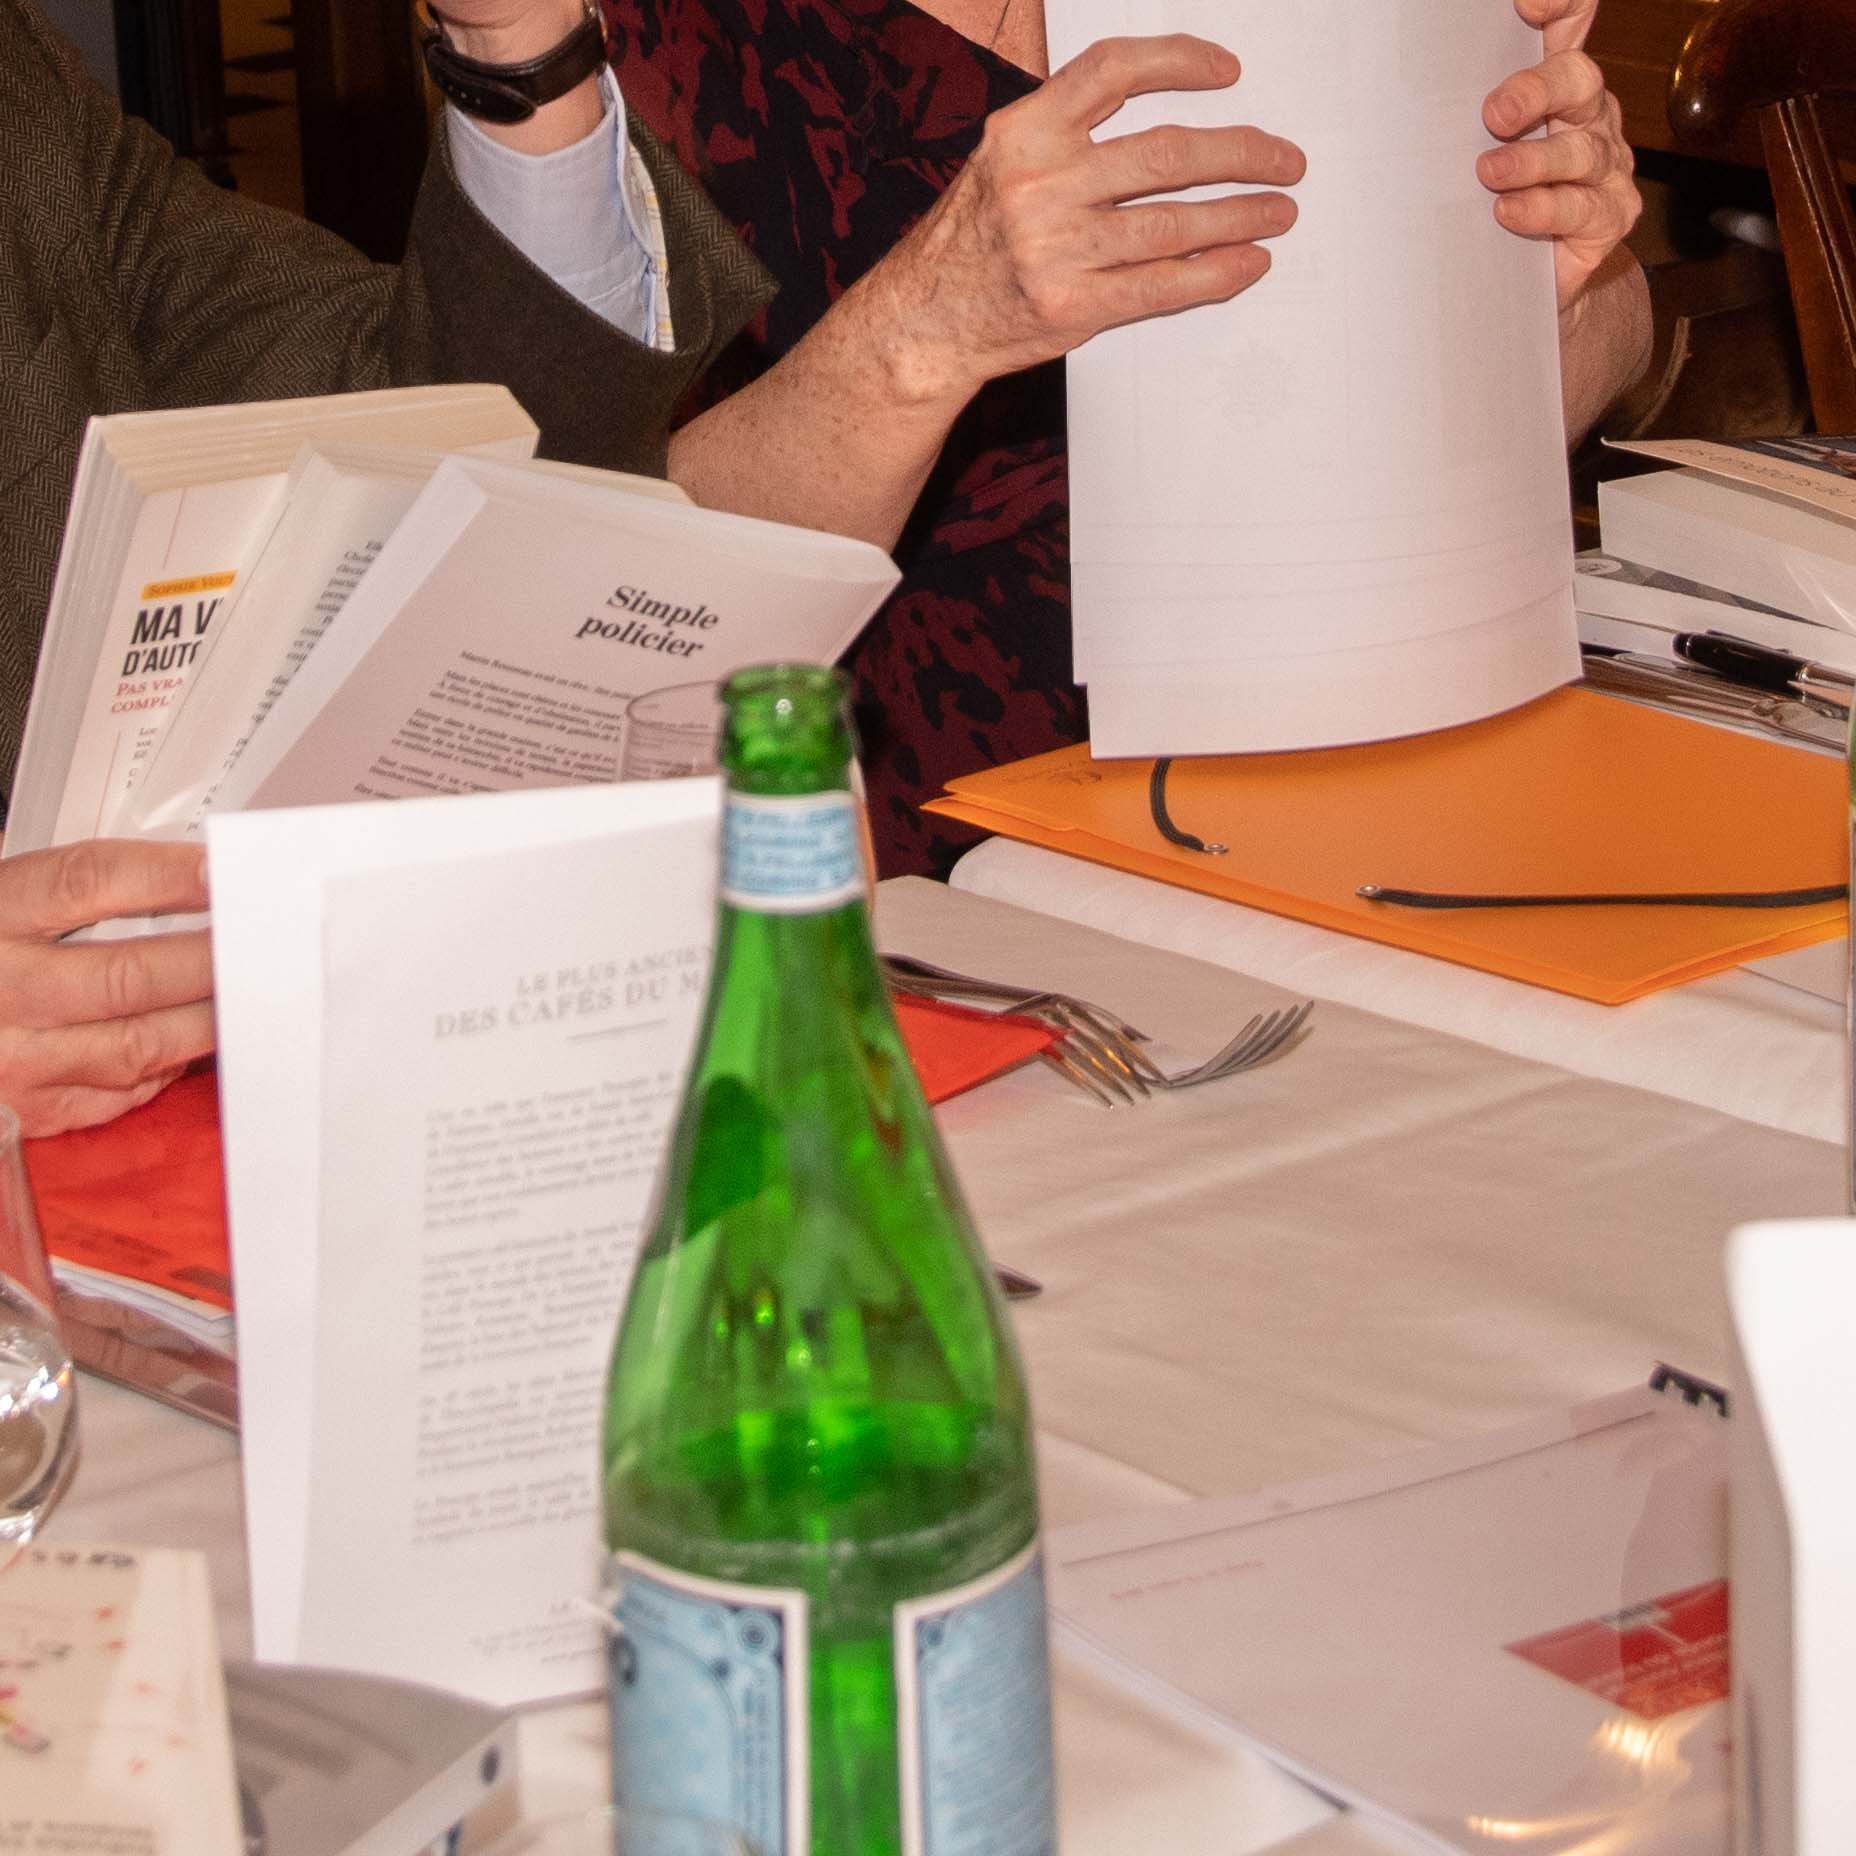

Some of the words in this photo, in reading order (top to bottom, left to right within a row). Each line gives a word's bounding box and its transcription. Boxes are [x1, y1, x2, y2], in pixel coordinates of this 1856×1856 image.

[129, 603, 183, 645] MA
[606, 584, 720, 630] Simple
[574, 616, 705, 658] policier
[111, 695, 175, 715] COMPL
[434, 1006, 497, 1040] DES
